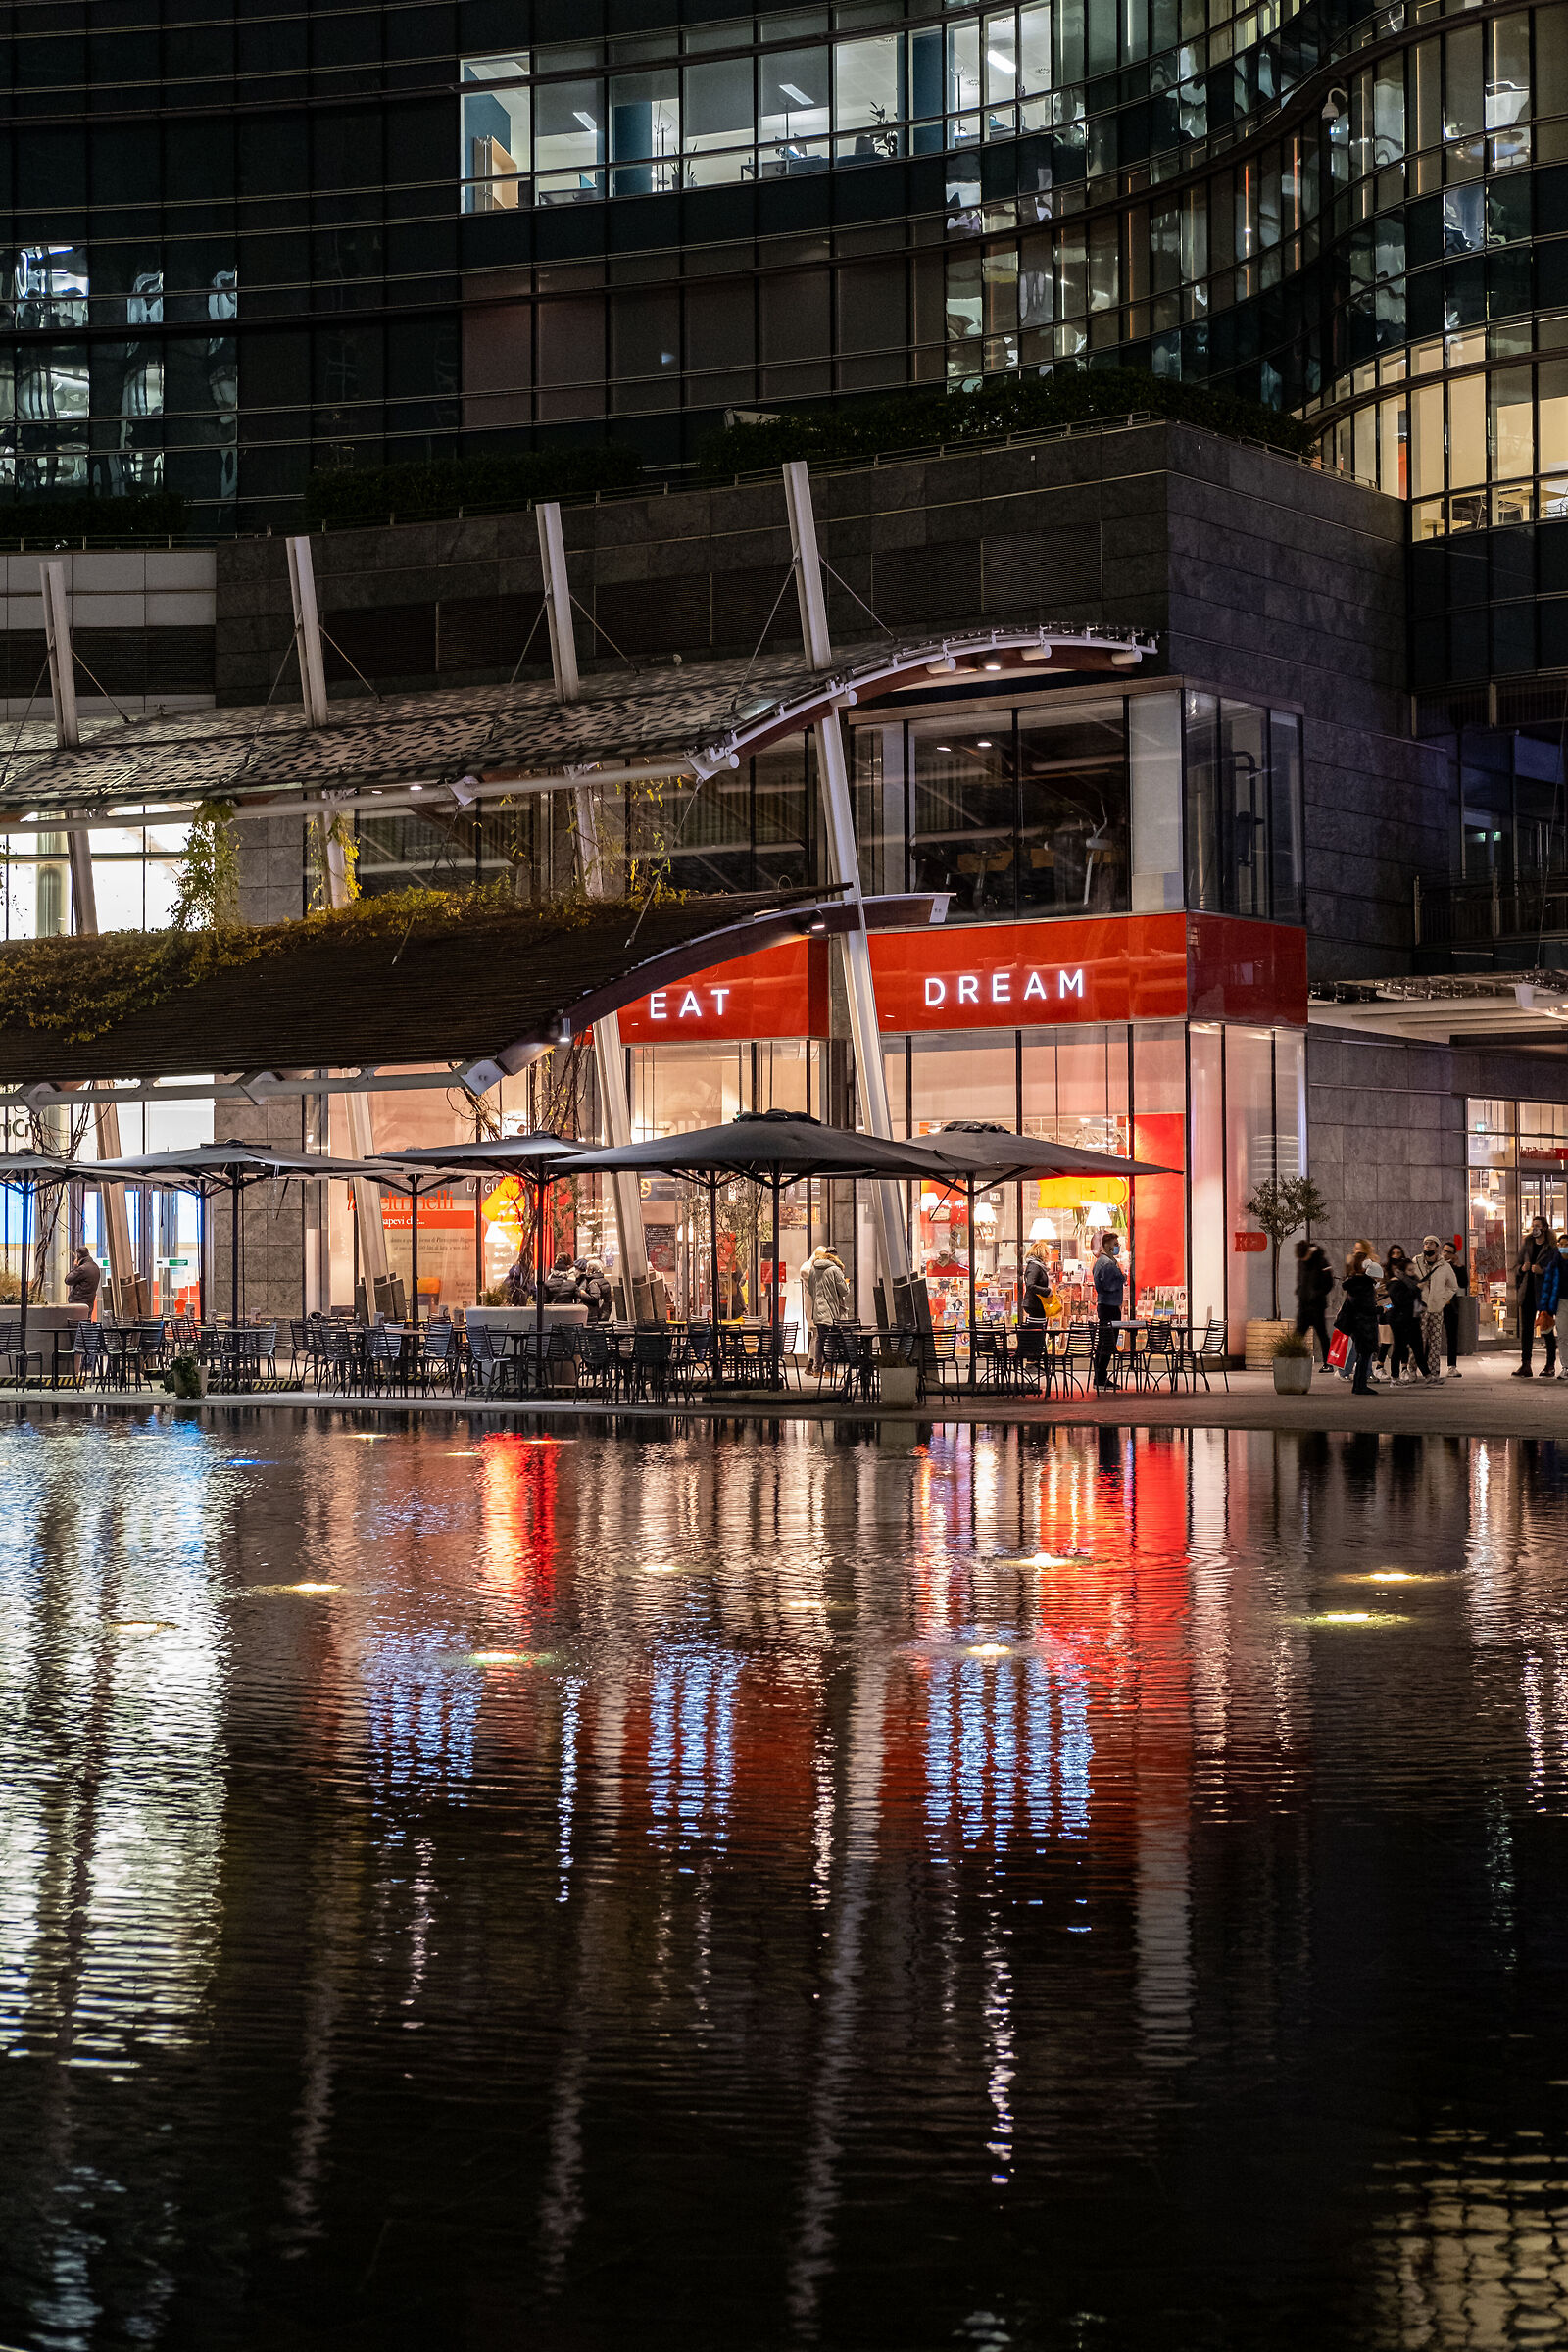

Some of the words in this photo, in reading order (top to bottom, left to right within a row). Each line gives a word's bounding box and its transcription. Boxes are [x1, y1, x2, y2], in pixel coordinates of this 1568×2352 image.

[925, 968, 1084, 1005] DREAM
[650, 989, 730, 1020] EAT
[379, 1190, 455, 1211] eltrinelli
